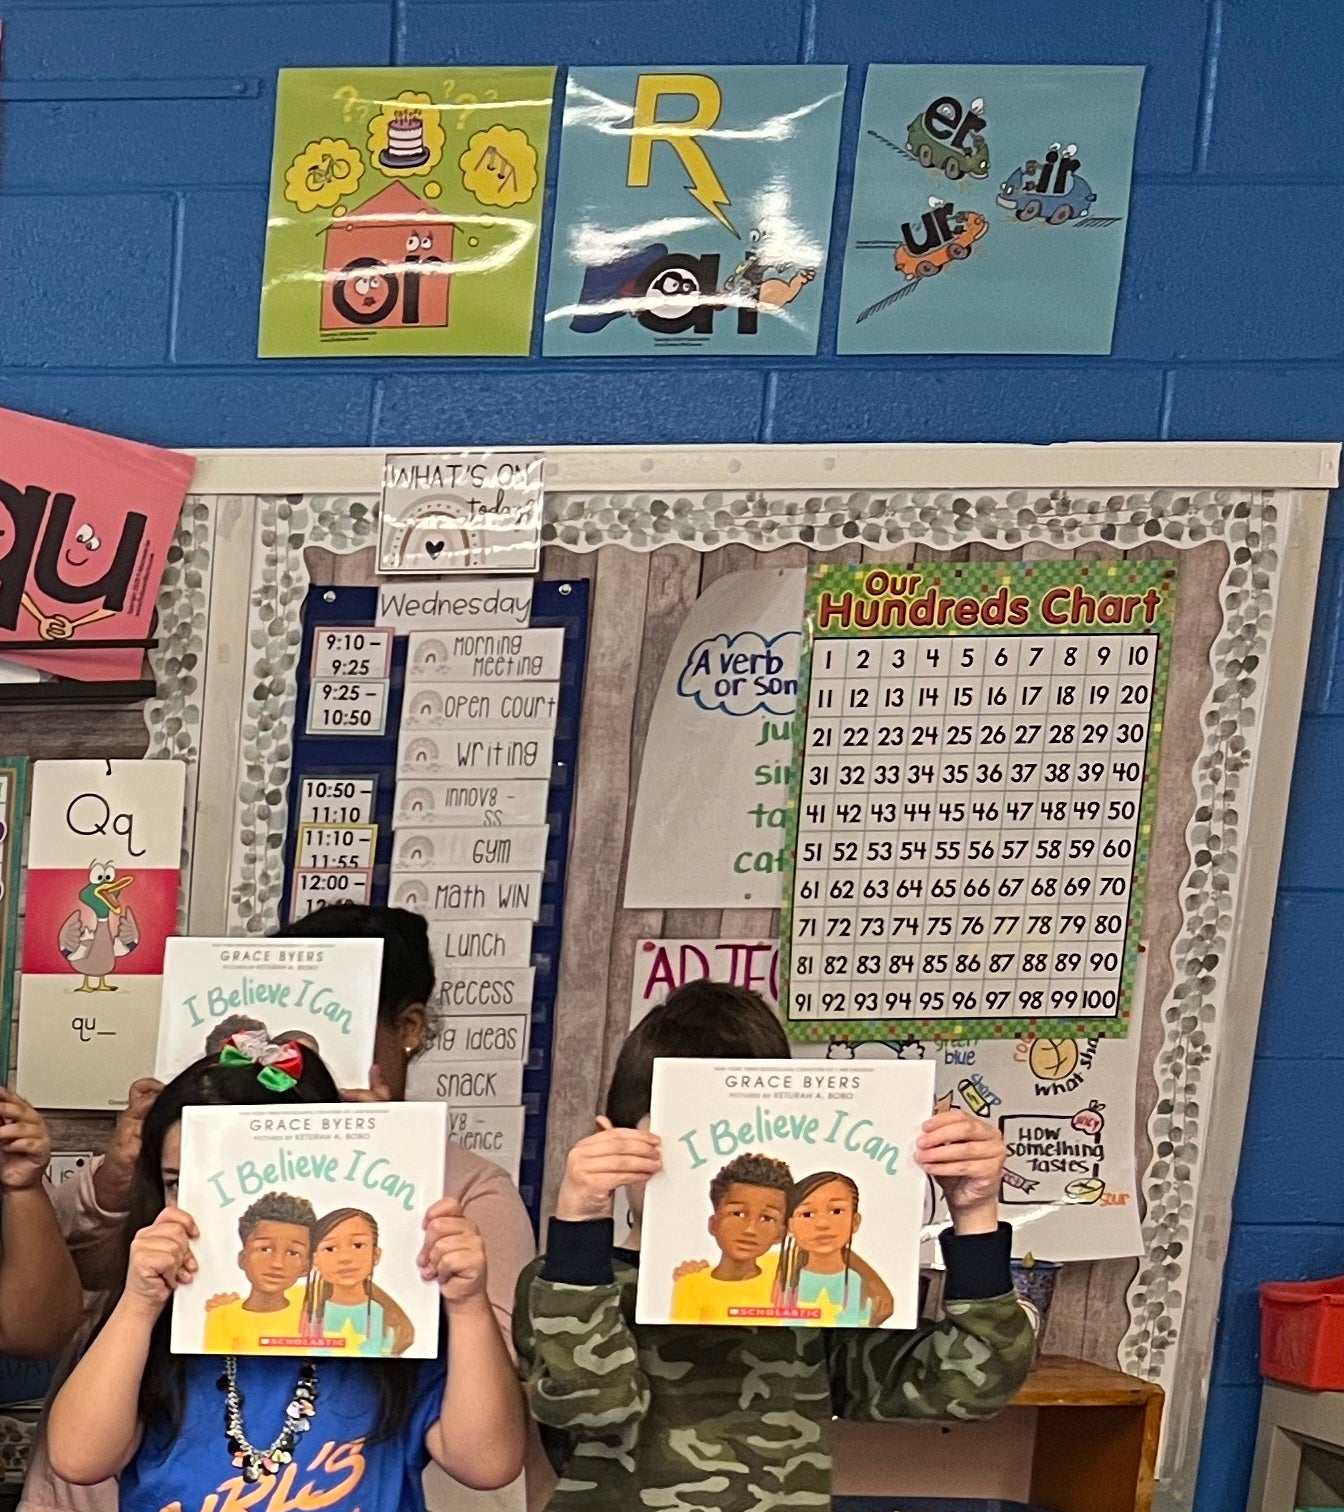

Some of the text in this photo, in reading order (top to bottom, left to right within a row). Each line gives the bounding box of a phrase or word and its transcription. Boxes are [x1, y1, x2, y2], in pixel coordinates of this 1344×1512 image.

[923, 92, 989, 155] er
[626, 74, 743, 241] R
[1046, 148, 1081, 195] ir
[901, 199, 954, 256] ur
[391, 464, 488, 488] WHAT'S
[866, 571, 922, 596] Our
[381, 590, 532, 623] Wednesday
[820, 586, 1161, 629] Hundreds Chart
[327, 634, 365, 650] 9:10
[332, 660, 370, 676] 9:25
[692, 648, 783, 676] A verb
[825, 645, 1149, 670] 1 2 3 4 5 6 7 8 9 10
[323, 685, 360, 701] 9:25
[713, 675, 745, 696] or
[323, 709, 371, 726] 10:50
[306, 782, 355, 798] 10:50
[312, 807, 360, 823] 11:10
[306, 830, 353, 846] 11:10
[311, 855, 359, 868] 11:55
[301, 875, 349, 890] 12:00
[499, 884, 530, 908] WIN
[945, 1049, 975, 1065] blue
[725, 1075, 861, 1089] GRACE BYERS
[1035, 1071, 1084, 1096] what
[678, 1106, 902, 1176] I Believe I Can
[1007, 1141, 1104, 1161] something
[740, 1308, 821, 1319] SCHOLASTIC
